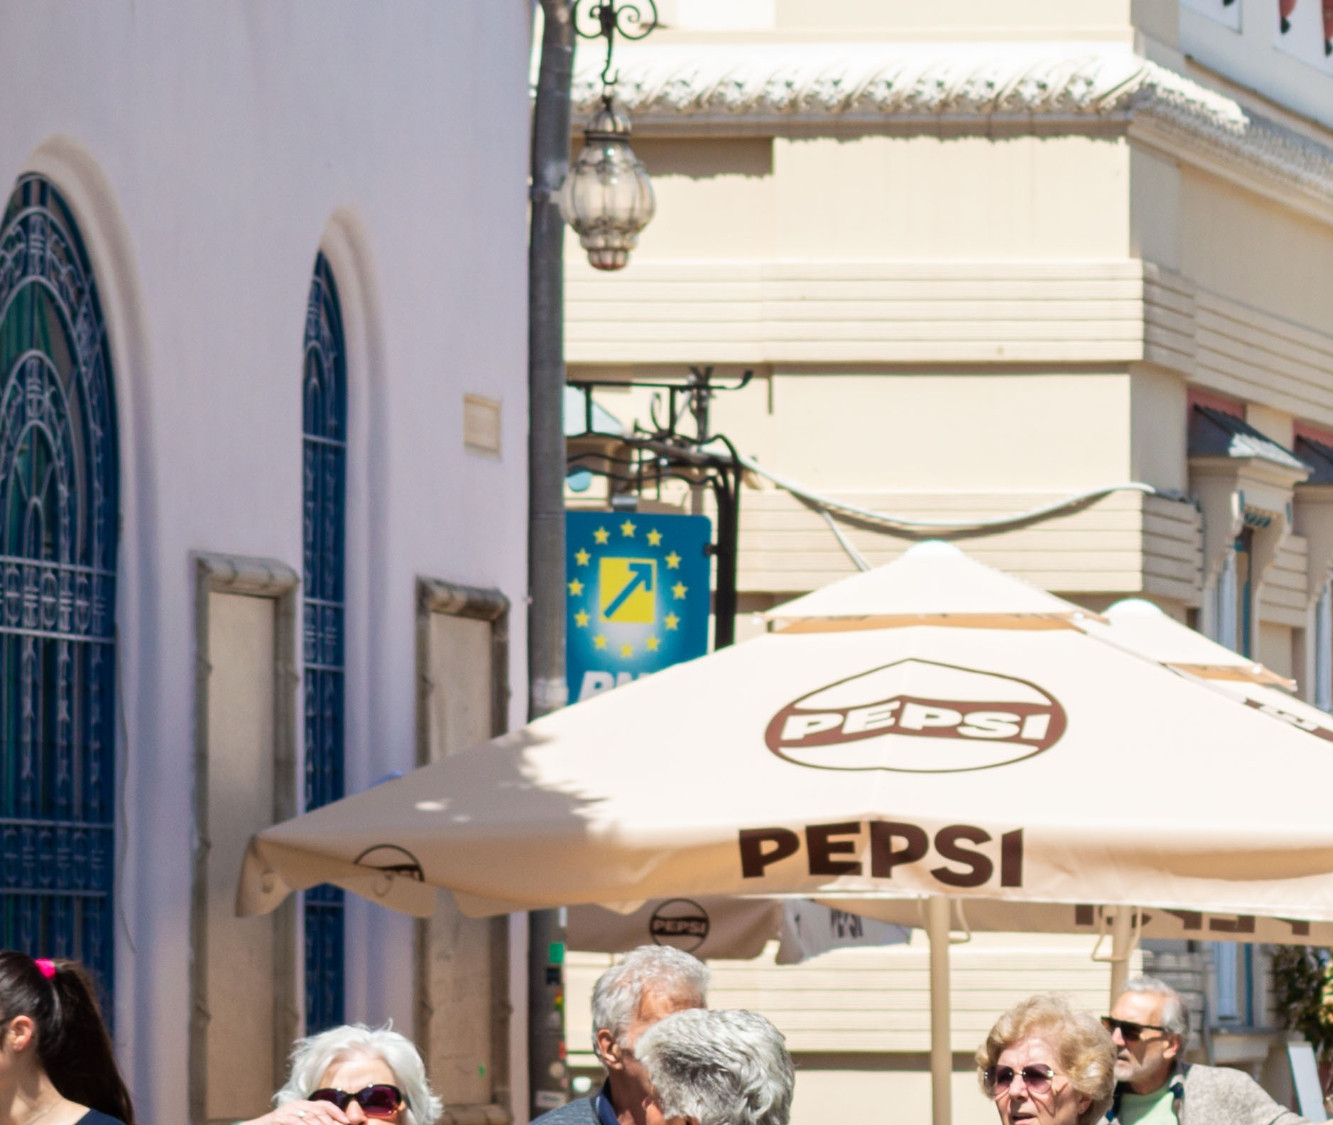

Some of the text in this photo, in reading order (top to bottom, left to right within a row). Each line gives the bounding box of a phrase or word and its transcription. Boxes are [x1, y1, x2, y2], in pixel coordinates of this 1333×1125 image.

[780, 701, 1051, 741] PEPSI
[738, 820, 1023, 888] PEPSI
[653, 919, 705, 934] PEPSI
